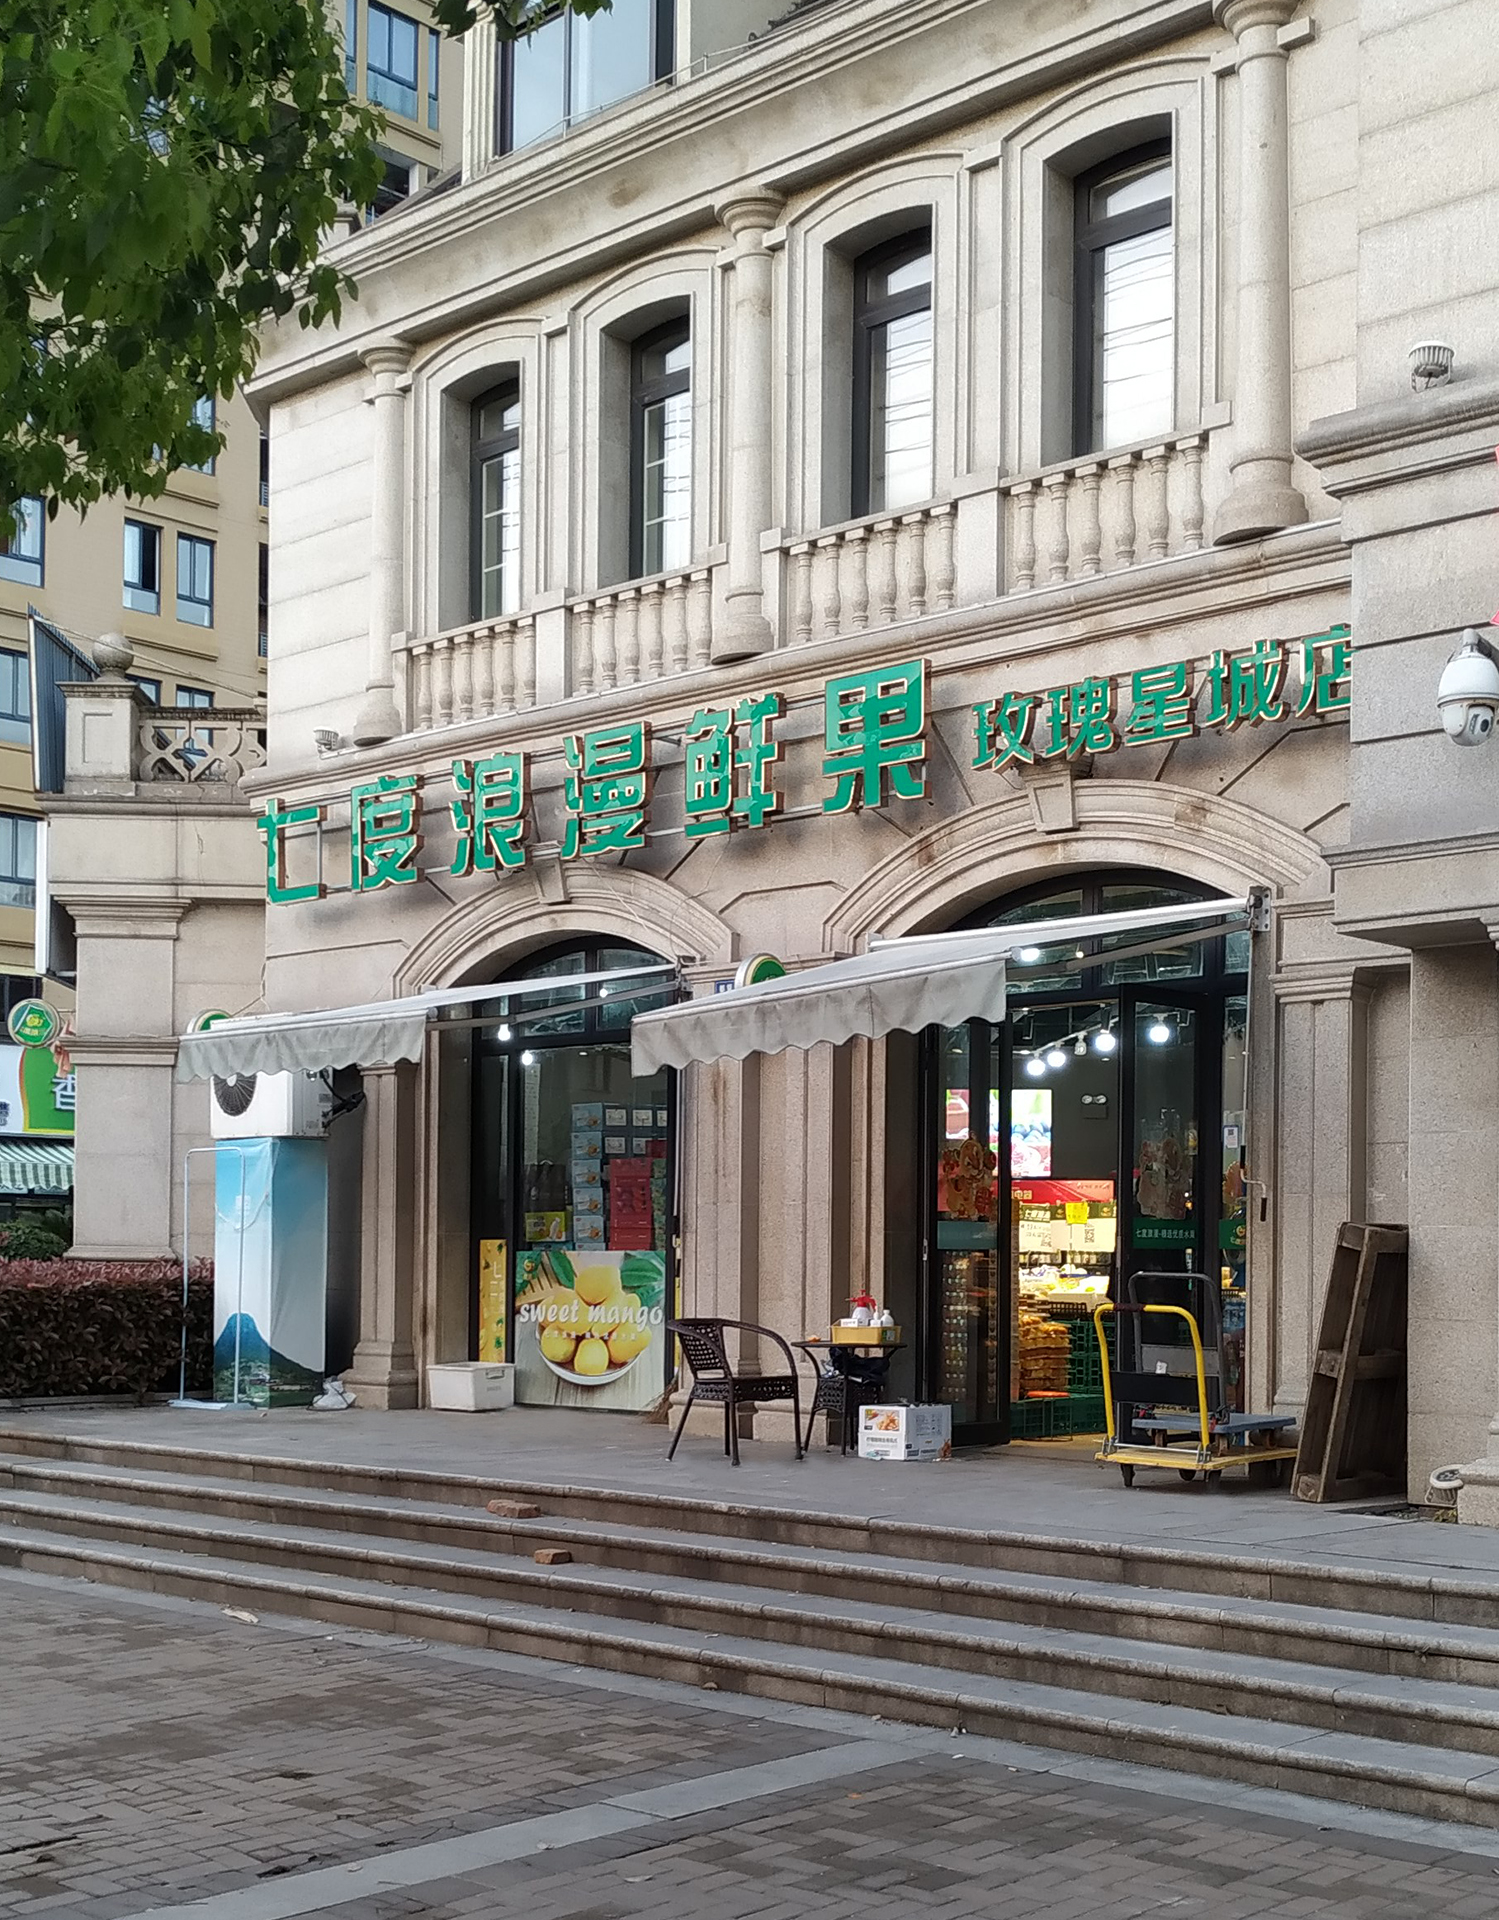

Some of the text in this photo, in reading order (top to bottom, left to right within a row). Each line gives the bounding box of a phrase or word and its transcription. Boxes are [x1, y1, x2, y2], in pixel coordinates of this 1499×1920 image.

[256, 623, 1352, 905] 七度浪漫鲜果 玫瑰星城店
[519, 1299, 664, 1332] sweet mango
